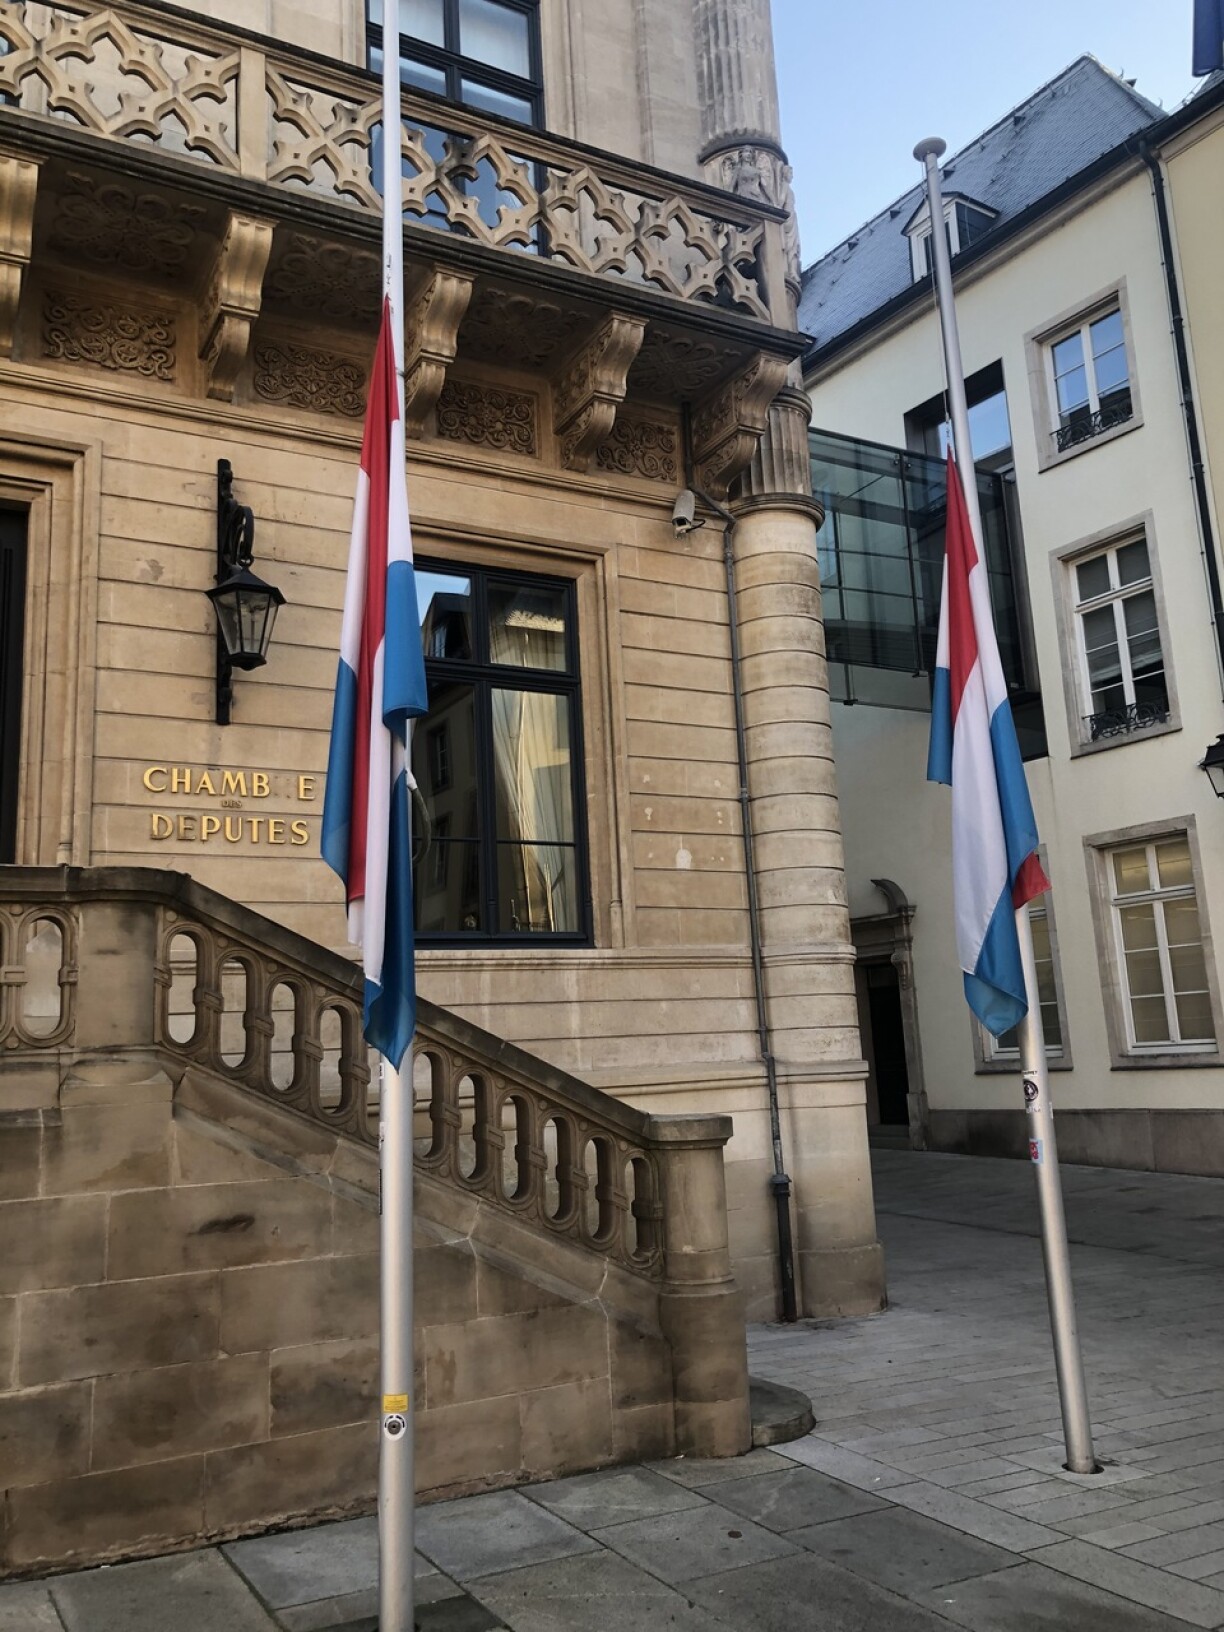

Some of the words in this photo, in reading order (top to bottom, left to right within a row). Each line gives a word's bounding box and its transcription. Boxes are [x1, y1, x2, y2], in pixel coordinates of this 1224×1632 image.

[143, 767, 316, 800] CHAMBE
[221, 800, 243, 809] DES
[150, 813, 310, 845] DEPUTES
